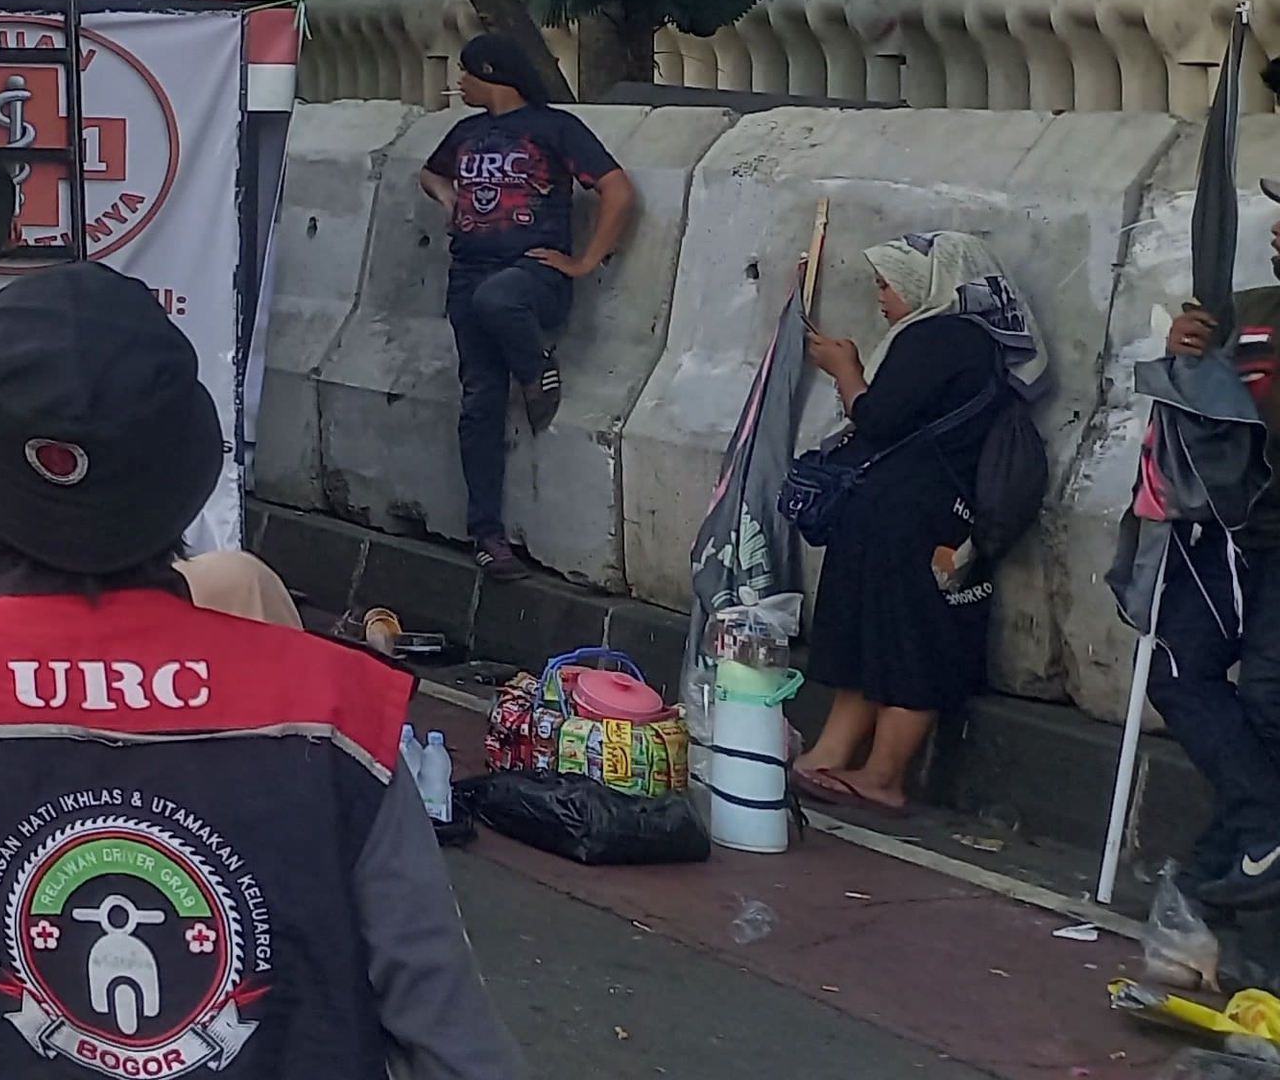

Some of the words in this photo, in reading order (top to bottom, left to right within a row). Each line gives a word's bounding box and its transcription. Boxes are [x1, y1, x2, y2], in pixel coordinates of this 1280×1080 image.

[459, 151, 530, 179] URC
[7, 660, 210, 710] URC
[17, 802, 58, 838] HATI
[59, 789, 123, 816] IKHLAS
[130, 791, 142, 808] &
[151, 795, 244, 873] UTAMAKAN
[235, 873, 272, 973] KELUARGA
[40, 850, 98, 907] RELAWAN
[102, 848, 156, 872] DRIVER
[160, 868, 196, 910] GRAB
[75, 1038, 187, 1077] BOGOR
